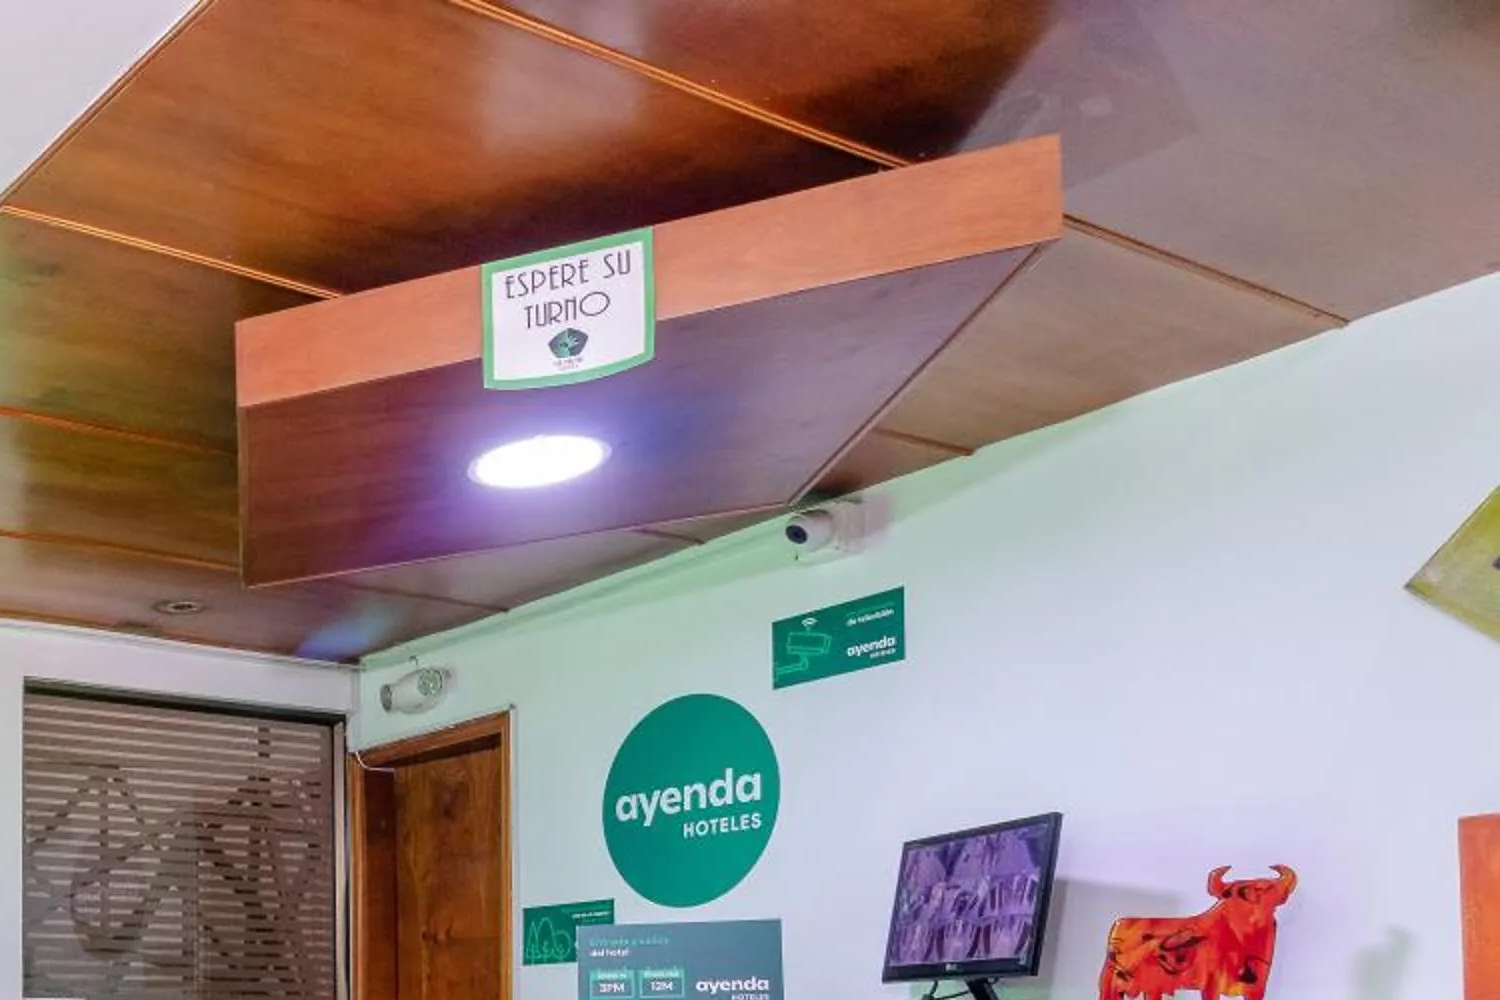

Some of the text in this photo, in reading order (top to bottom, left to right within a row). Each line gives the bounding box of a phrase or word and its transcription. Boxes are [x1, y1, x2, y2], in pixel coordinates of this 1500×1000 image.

[505, 249, 631, 299] ESPERE SU
[524, 291, 611, 329] TURNO
[846, 635, 897, 657] ayenda
[615, 767, 762, 827] ayenda
[683, 813, 762, 839] HOTELES
[695, 975, 769, 995] ayenda
